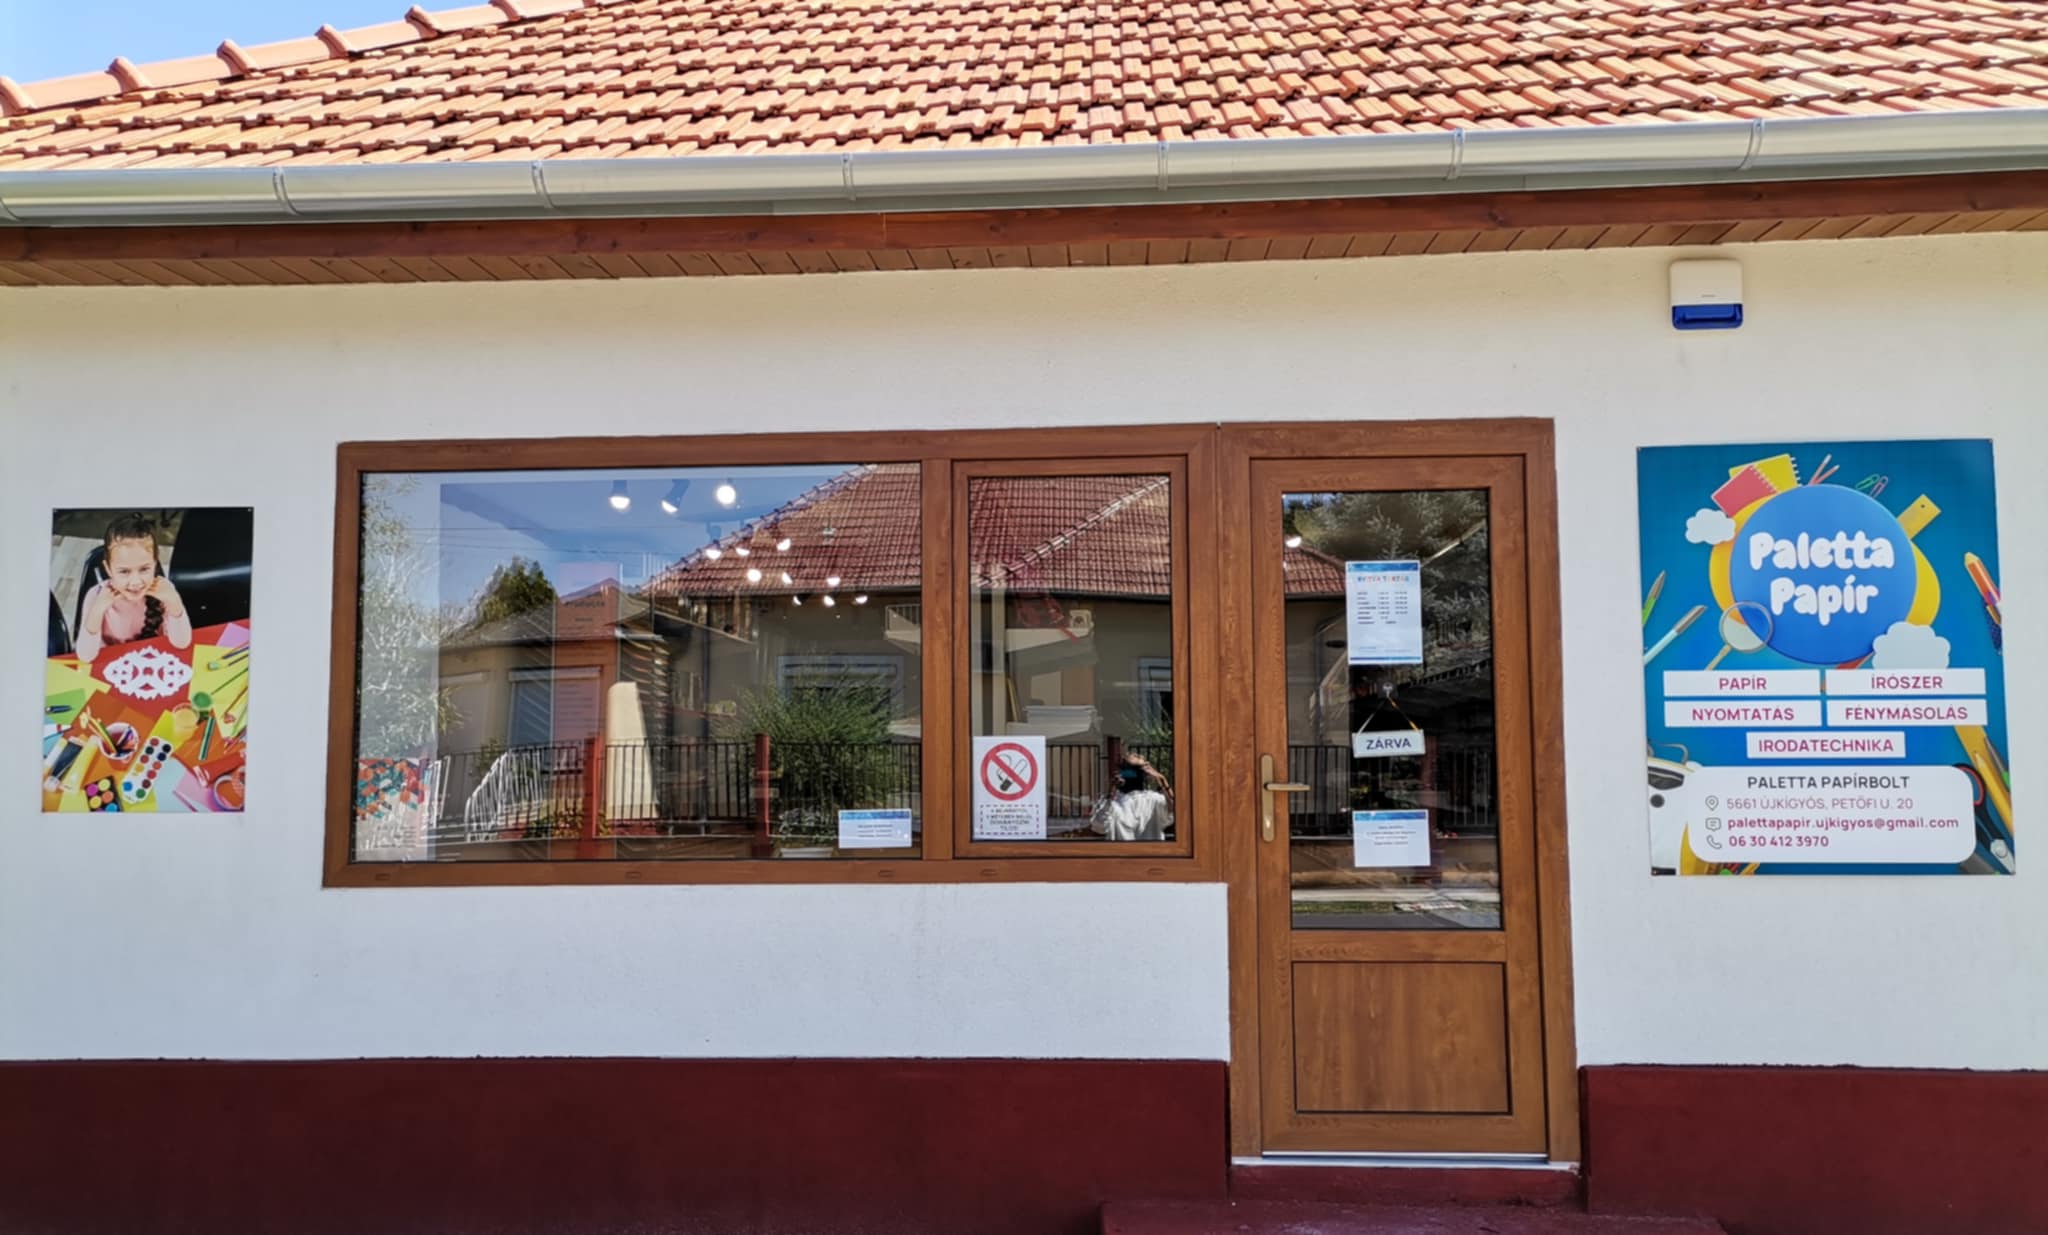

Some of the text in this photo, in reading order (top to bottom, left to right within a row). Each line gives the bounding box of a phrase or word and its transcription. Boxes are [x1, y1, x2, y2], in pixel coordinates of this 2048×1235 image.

[1749, 531, 1894, 570] Paletta
[1770, 575, 1879, 626] Papír
[1718, 675, 1767, 691] PAPÍR
[1871, 674, 1944, 690] ÍRÓSZER
[1691, 705, 1795, 721] NYOMTATÁS
[1845, 703, 1969, 720] FÉNYMÁSOLÁS
[1366, 736, 1412, 751] ZÁRVA
[1758, 738, 1895, 753] IRODATECHNIKA
[1747, 772, 1910, 789] PALETTA PAPÍRBOLT
[1726, 796, 1914, 811] 5661 ÚJKÍGYÓS, PETŐFI U. 20
[1727, 816, 1960, 831] palettapapir.ujkigyos@gmail.com
[1728, 836, 1829, 847] 06 30 412 3970
